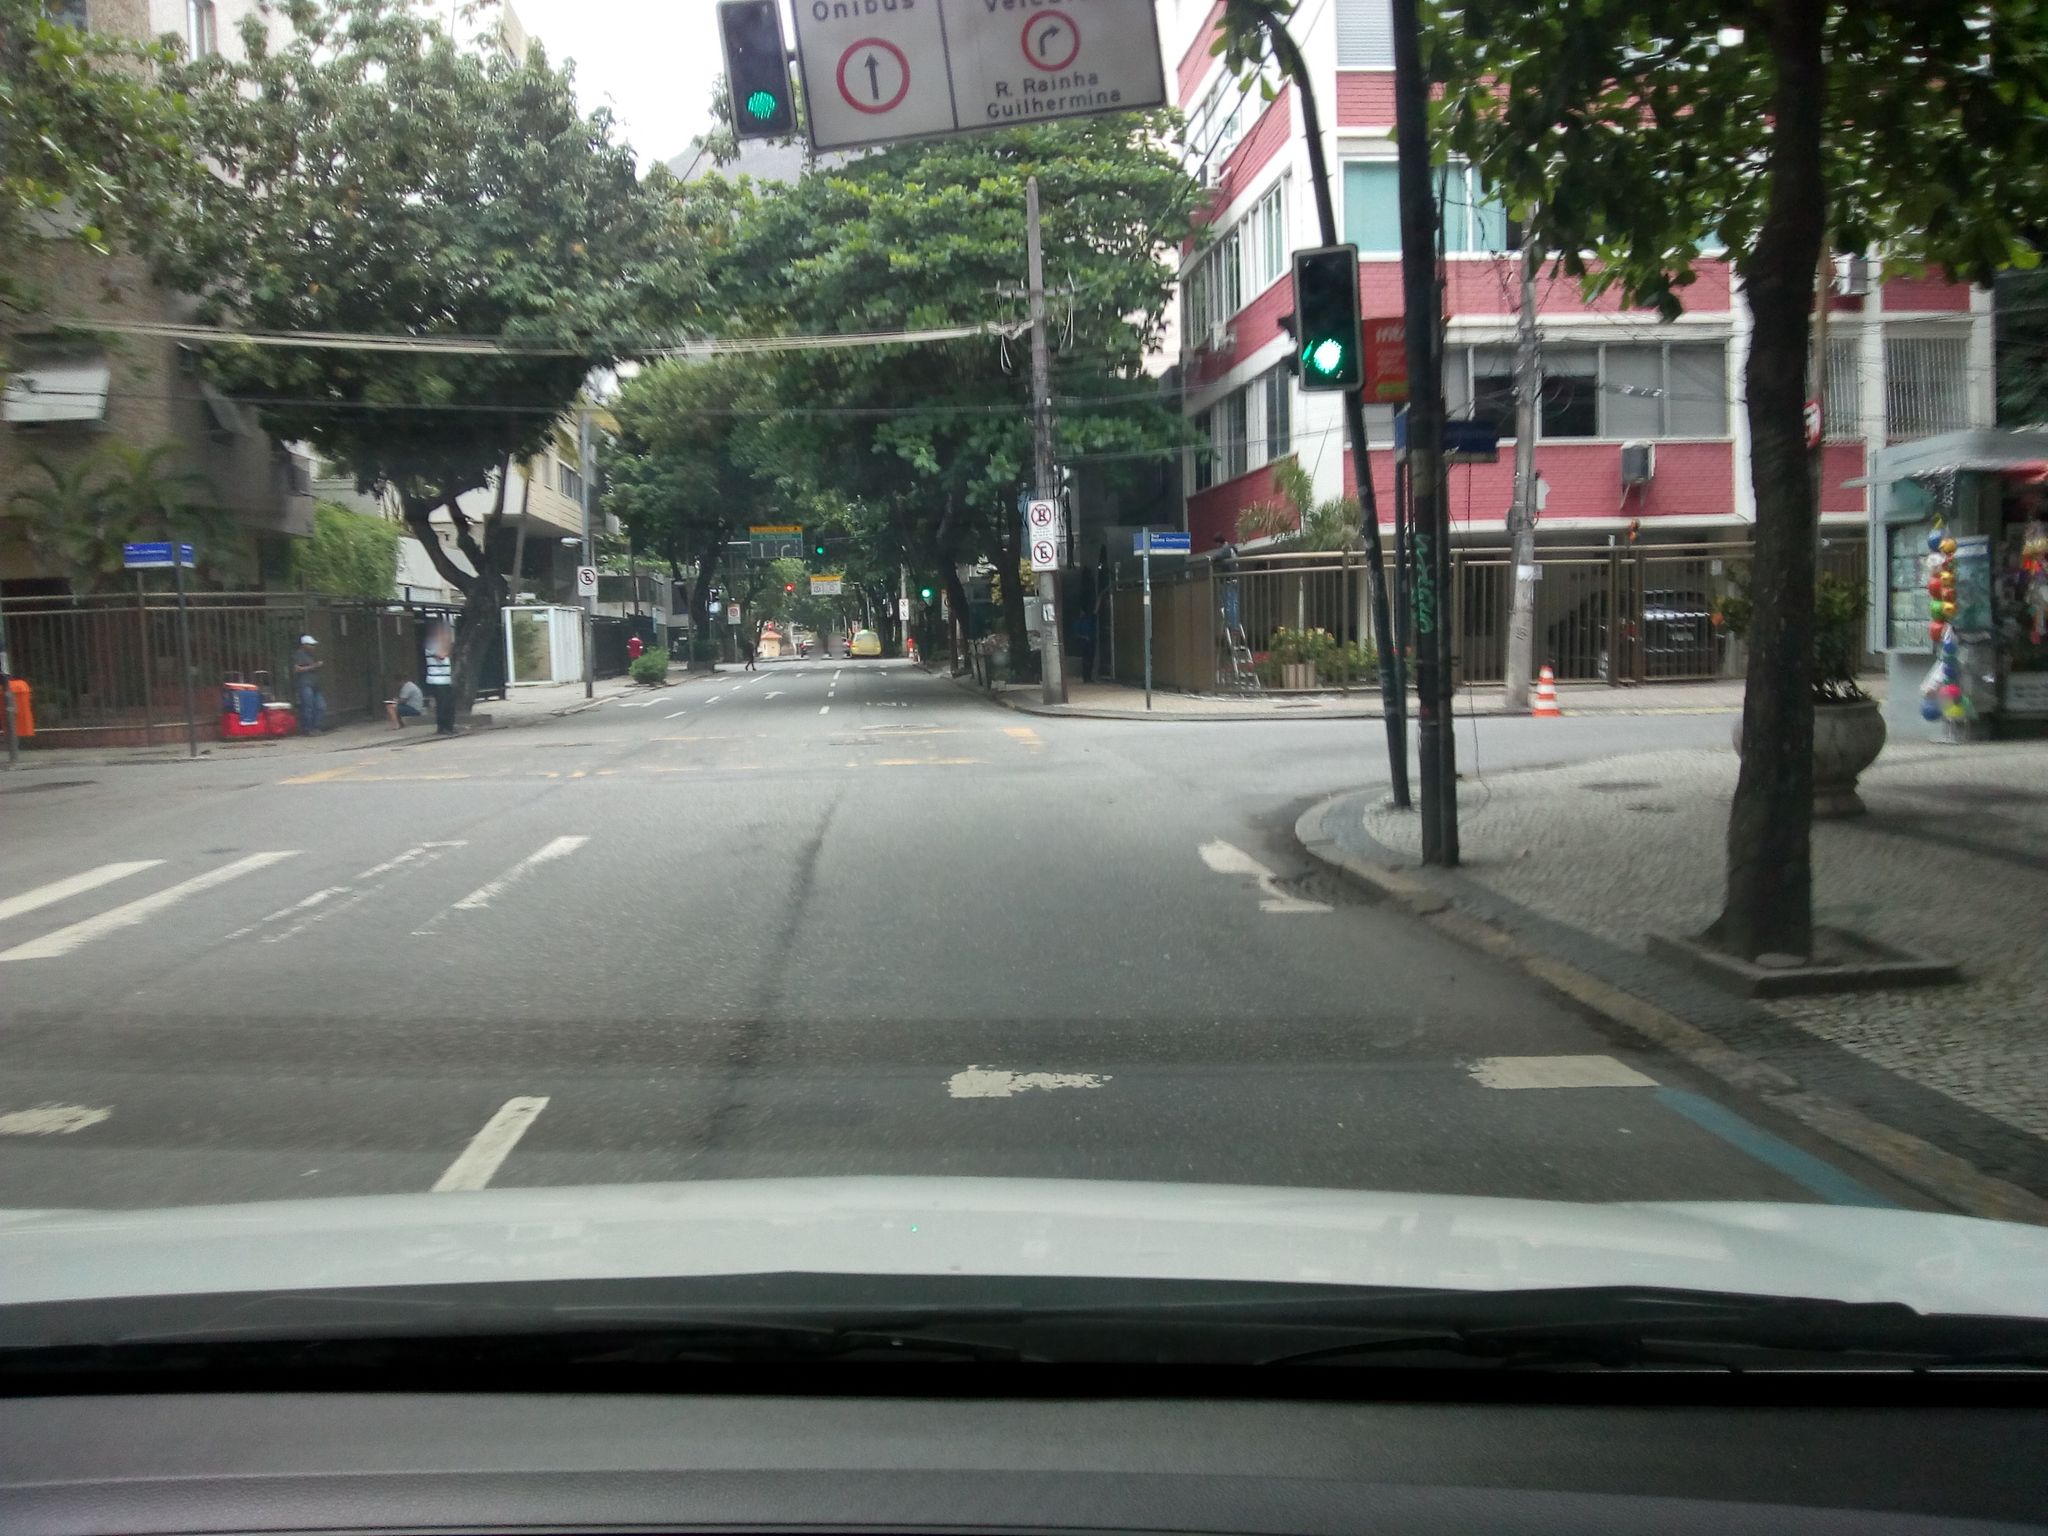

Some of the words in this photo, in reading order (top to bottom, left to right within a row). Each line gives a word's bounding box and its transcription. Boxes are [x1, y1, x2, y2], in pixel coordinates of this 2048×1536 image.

[995, 80, 1012, 97] R.
[1023, 71, 1099, 94] Rainha
[986, 88, 1121, 119] Guilhermina
